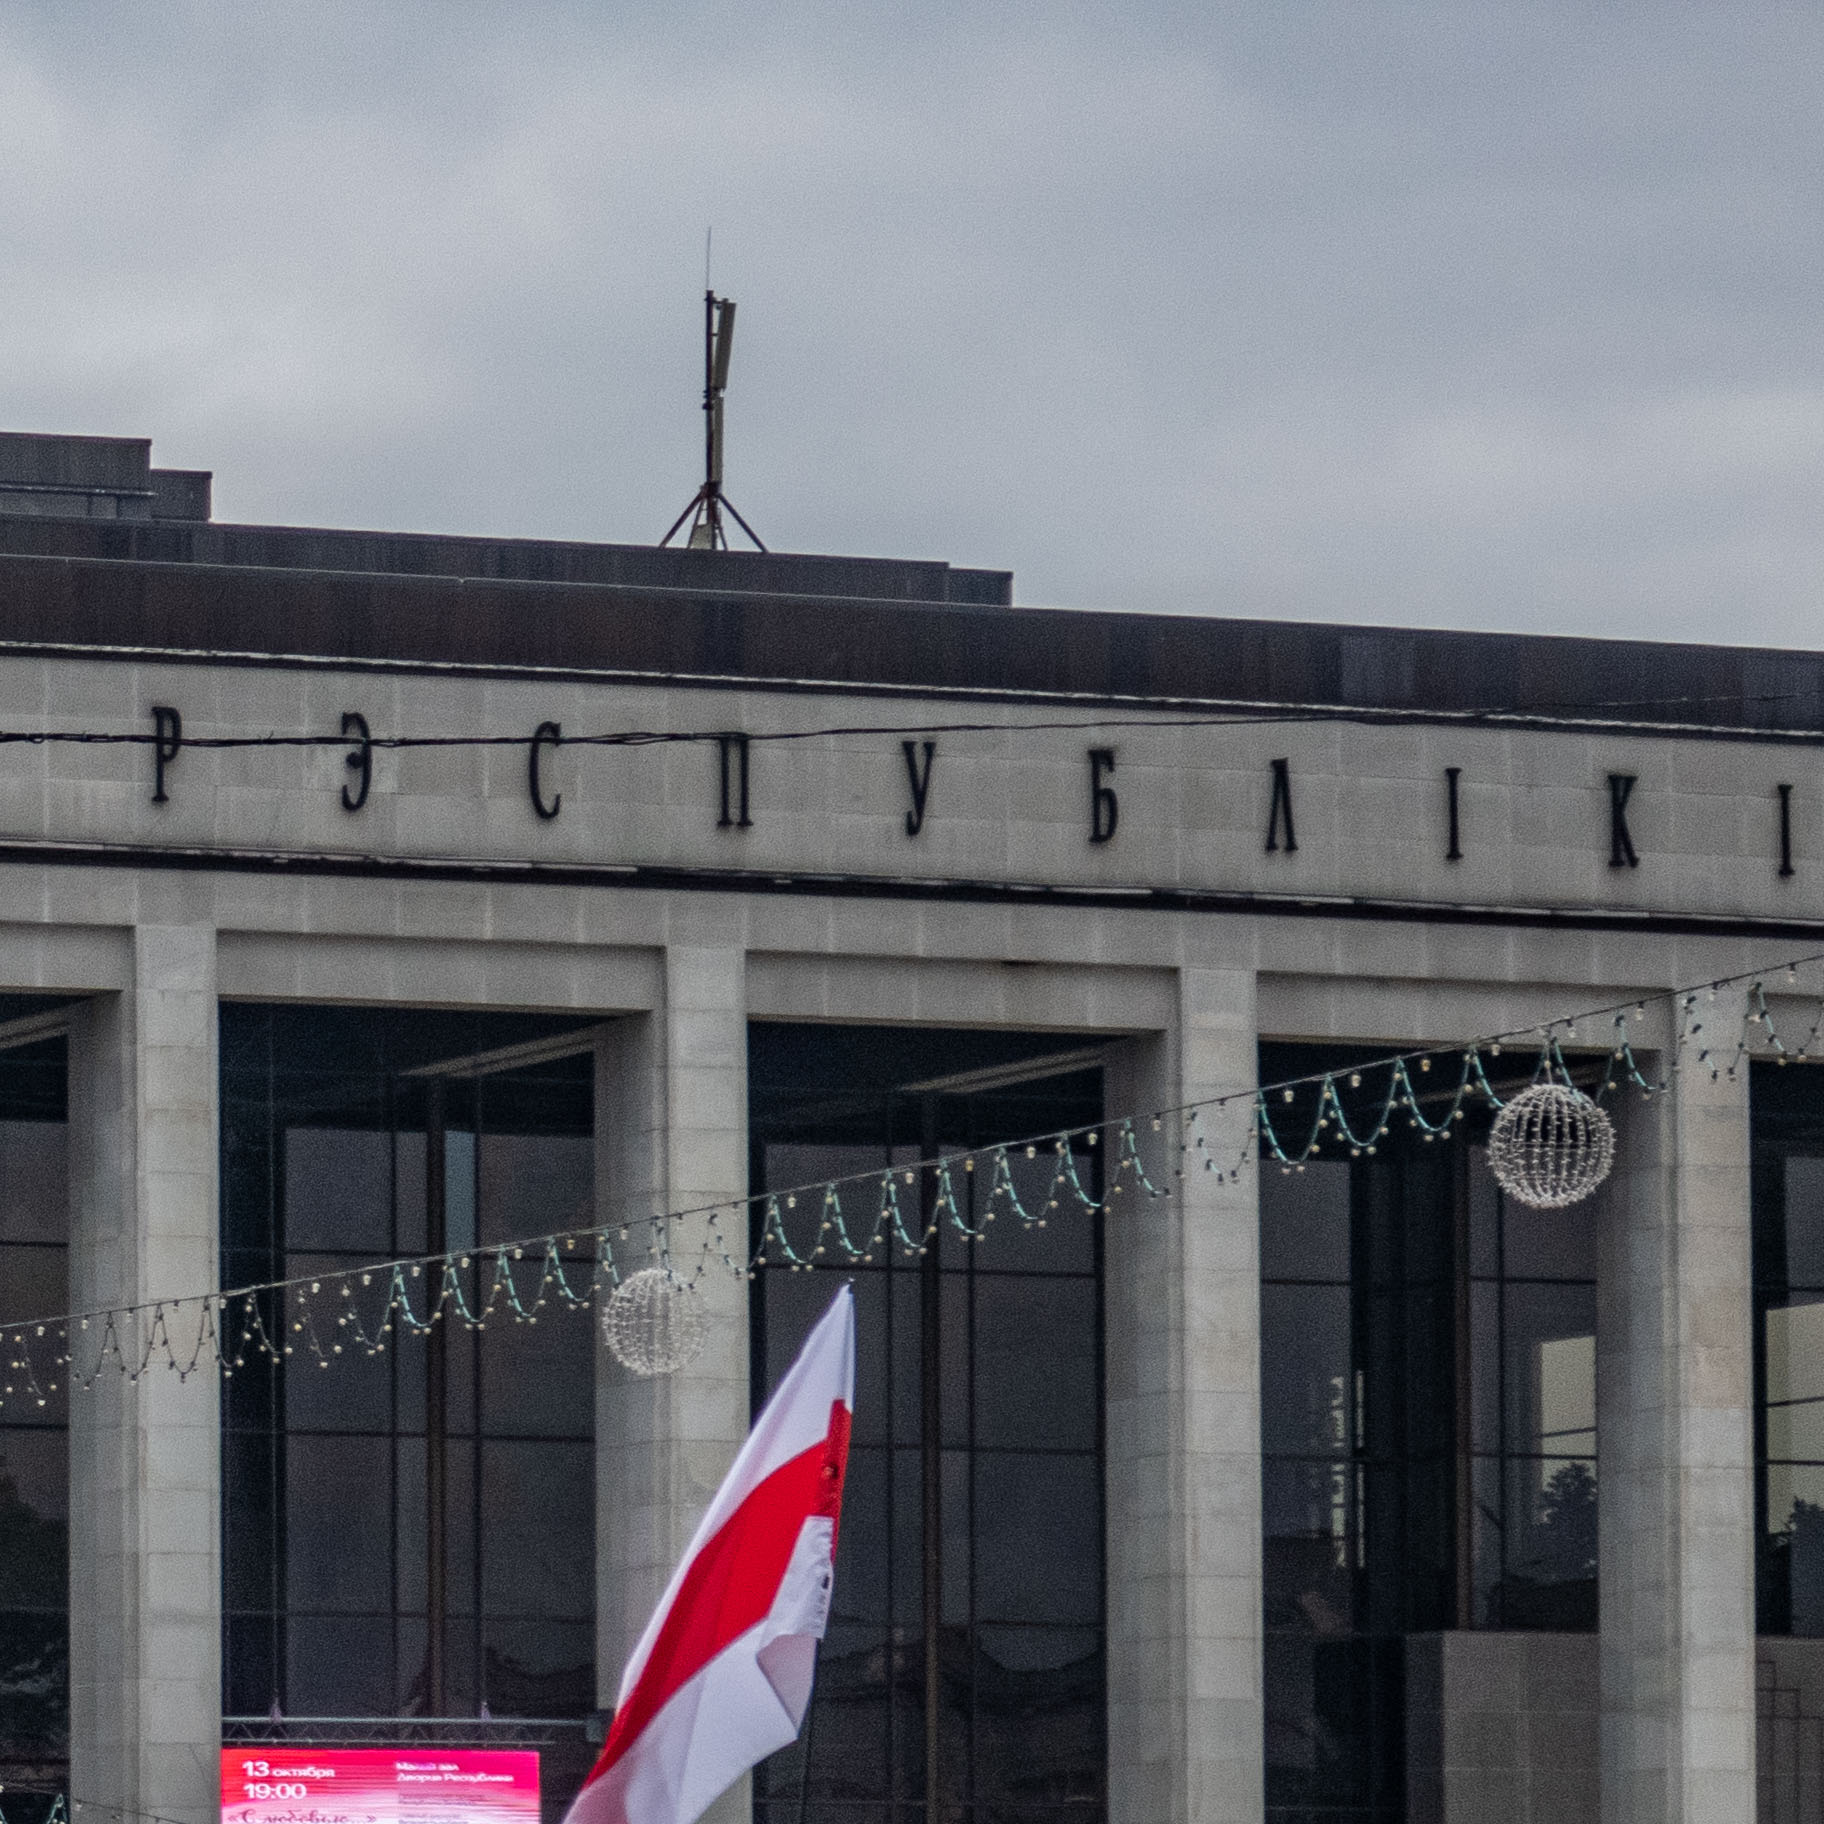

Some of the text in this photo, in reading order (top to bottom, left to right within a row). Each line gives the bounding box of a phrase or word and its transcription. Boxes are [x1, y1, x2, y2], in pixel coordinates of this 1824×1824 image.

[151, 704, 1795, 878] РЭСПУБЛІКІ
[241, 1760, 336, 1779] 13 октября
[242, 1783, 308, 1800] 19:00
